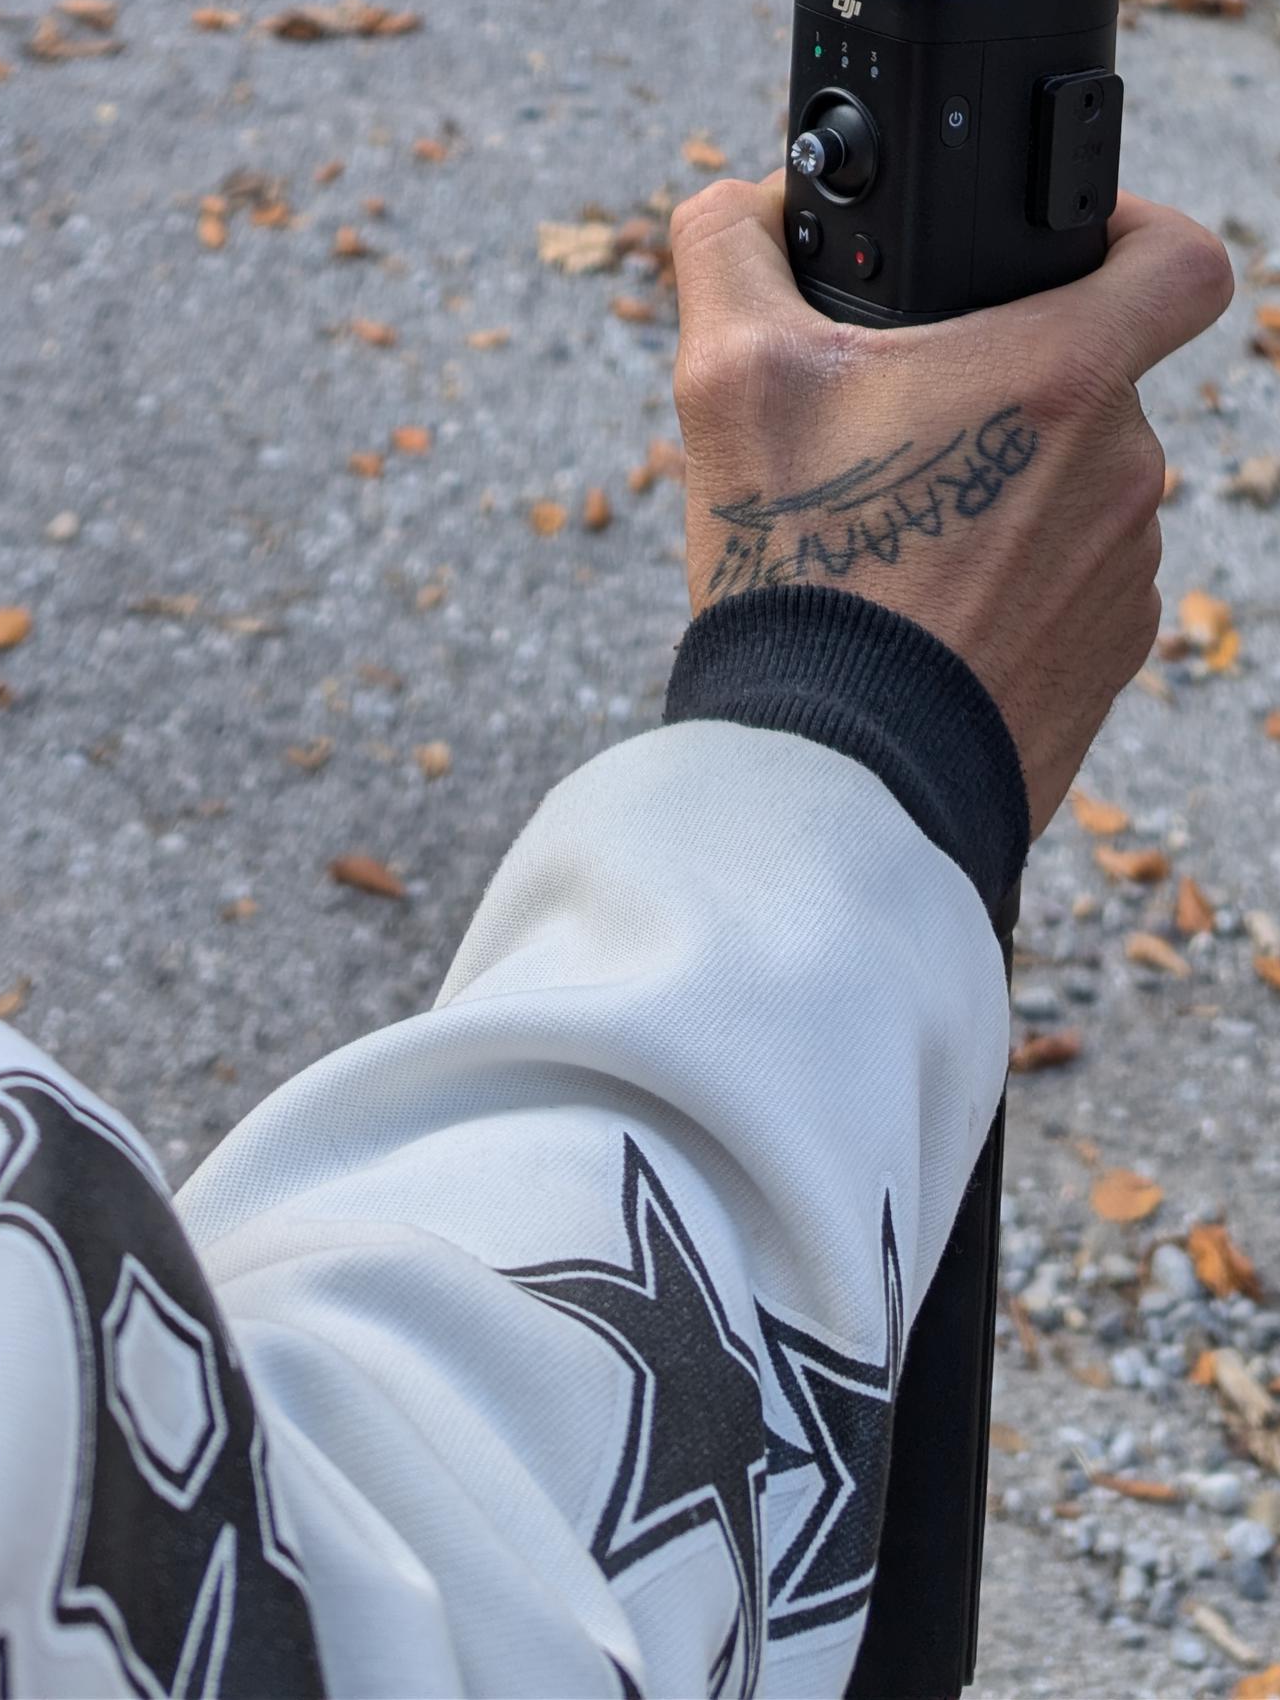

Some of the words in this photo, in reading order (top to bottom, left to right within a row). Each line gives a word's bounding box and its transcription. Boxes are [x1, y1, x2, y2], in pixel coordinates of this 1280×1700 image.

[841, 41, 848, 53] 2
[870, 50, 878, 62] 3
[798, 226, 810, 241] M
